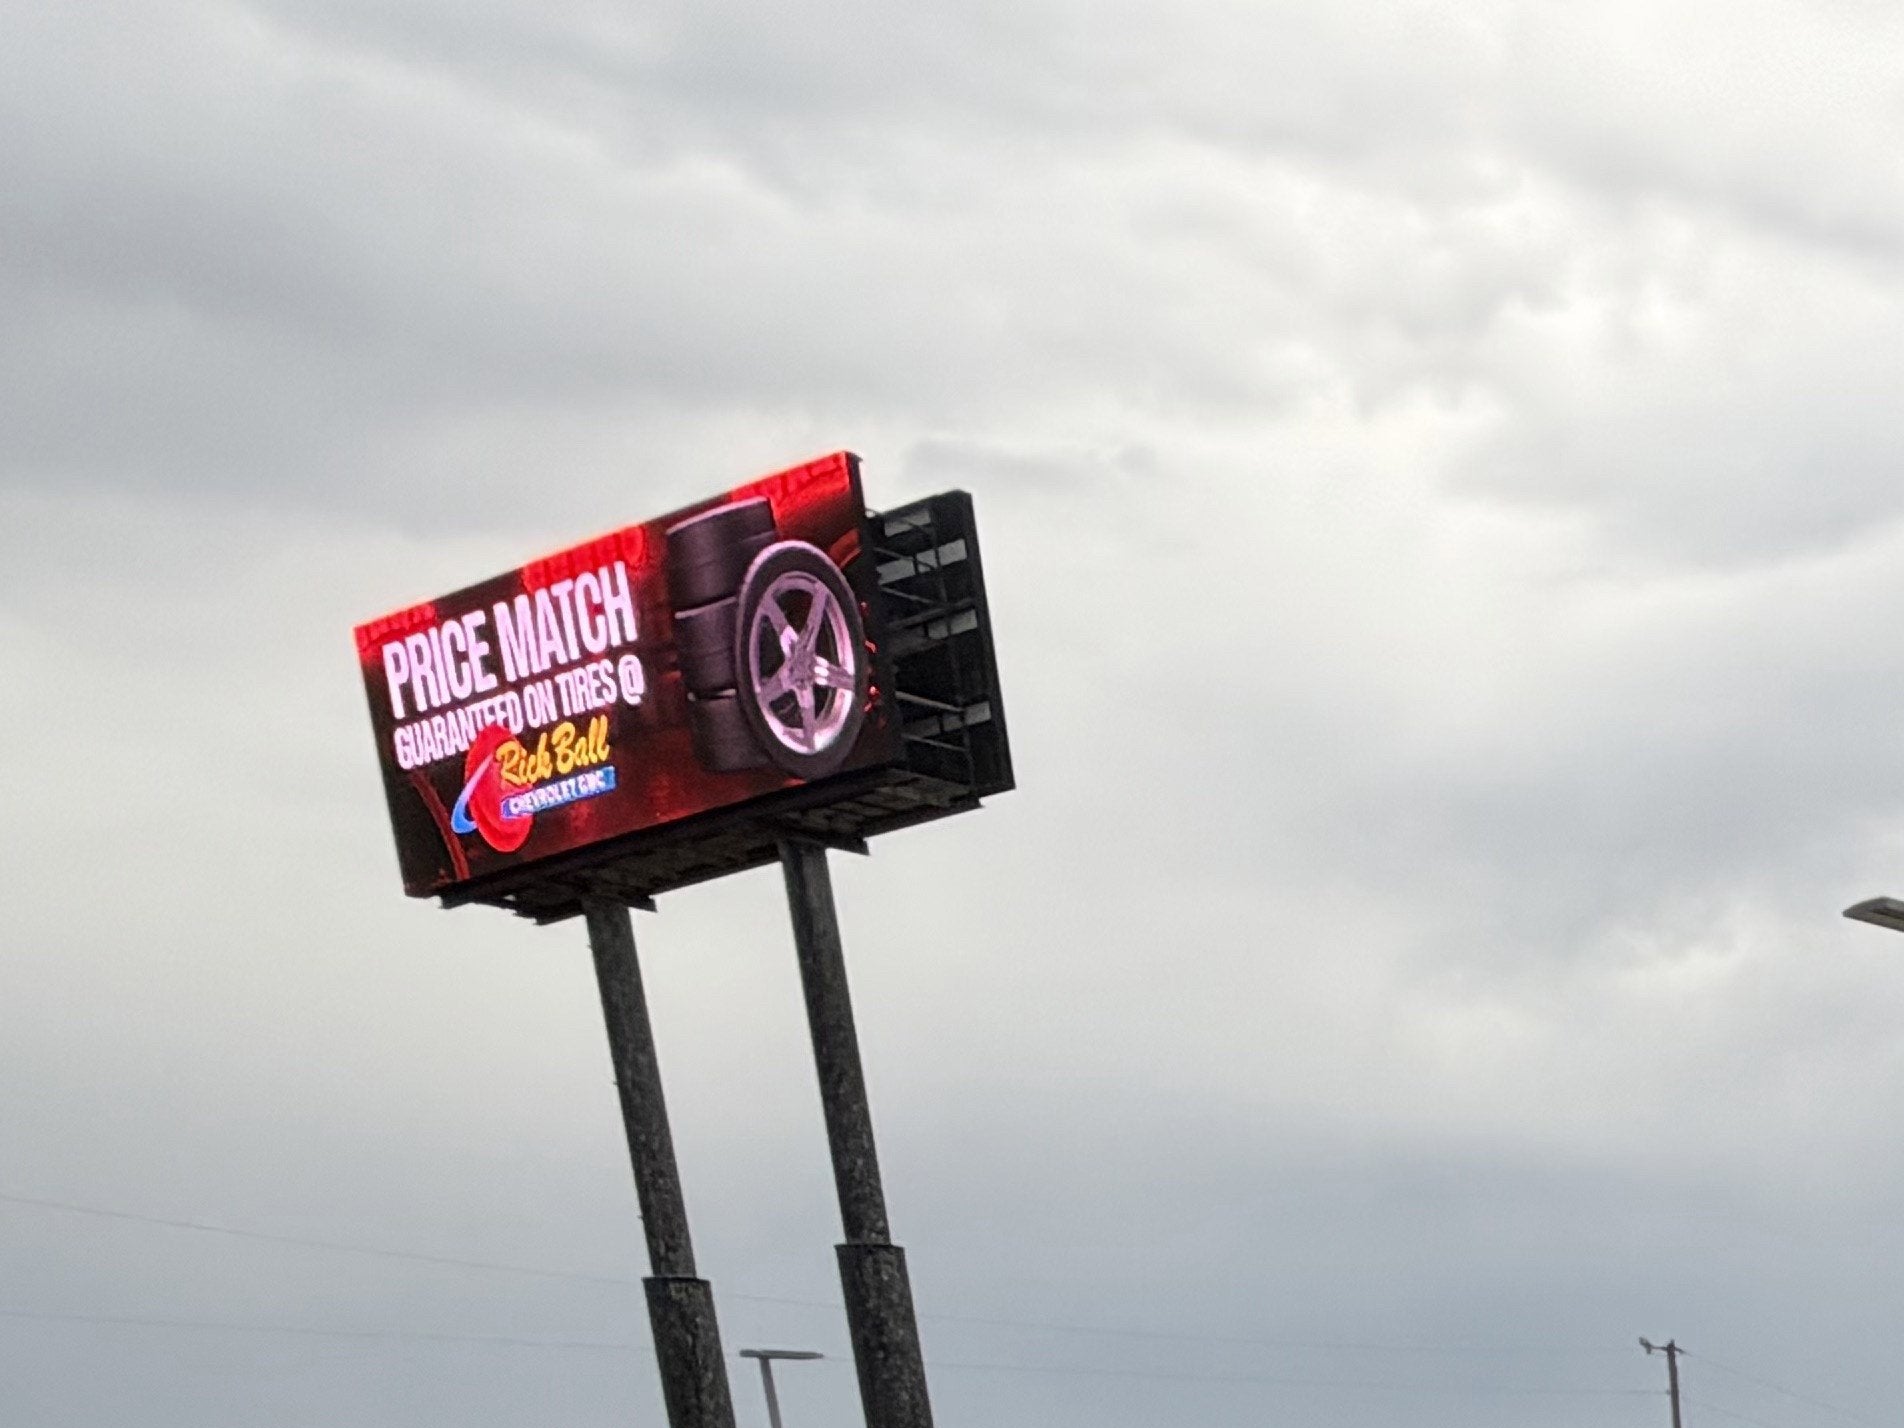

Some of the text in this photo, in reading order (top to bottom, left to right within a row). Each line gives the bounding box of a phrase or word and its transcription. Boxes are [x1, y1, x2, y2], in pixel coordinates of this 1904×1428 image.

[383, 560, 638, 719] PRICE MATCH
[394, 653, 645, 770] GUARANTEED ON TIRES @
[496, 714, 611, 787] Rick Ball
